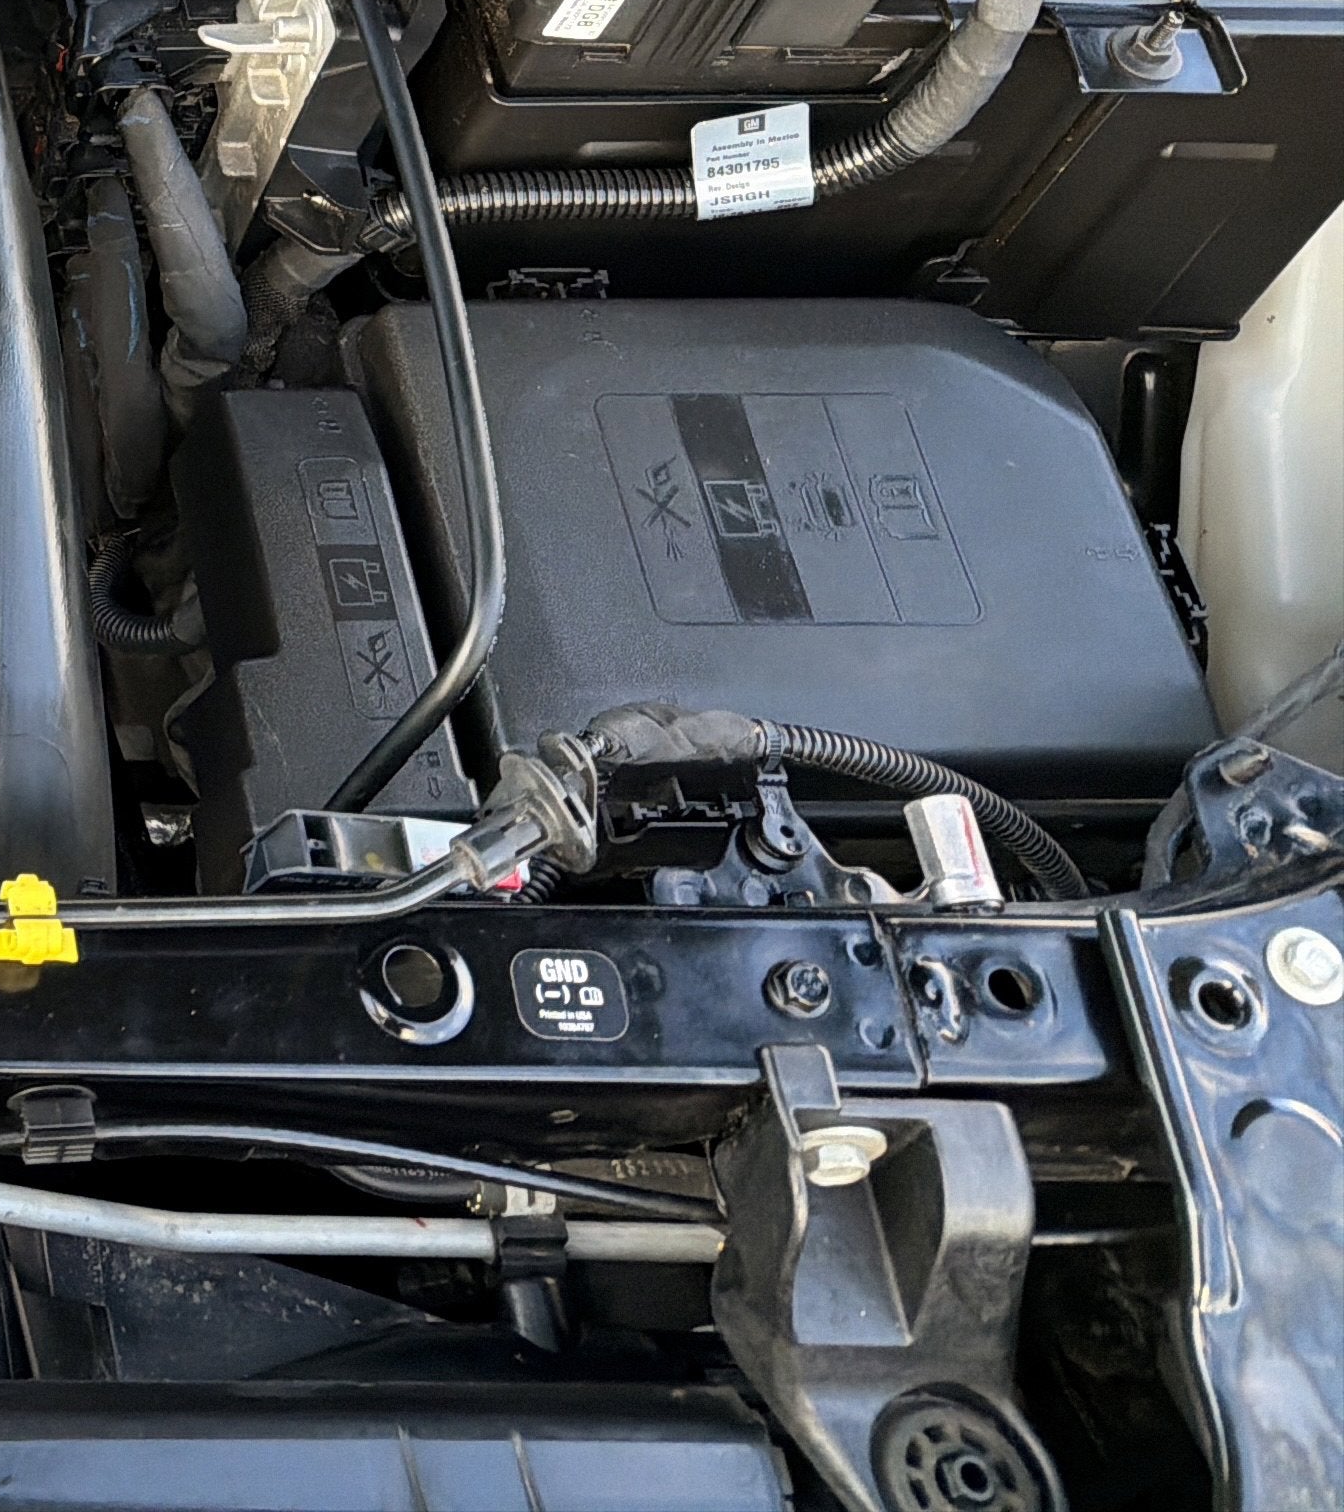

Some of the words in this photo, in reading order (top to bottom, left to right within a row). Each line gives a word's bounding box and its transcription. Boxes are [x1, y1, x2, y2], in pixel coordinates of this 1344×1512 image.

[712, 140, 754, 152] Assembly
[768, 133, 800, 144] Mexico
[723, 152, 750, 160] Number
[707, 157, 780, 178] 84301795
[710, 190, 770, 206] JSRGH
[539, 958, 589, 983] GND
[539, 1009, 567, 1020] Printed
[567, 1010, 575, 1020] in
[575, 1010, 593, 1020] USA
